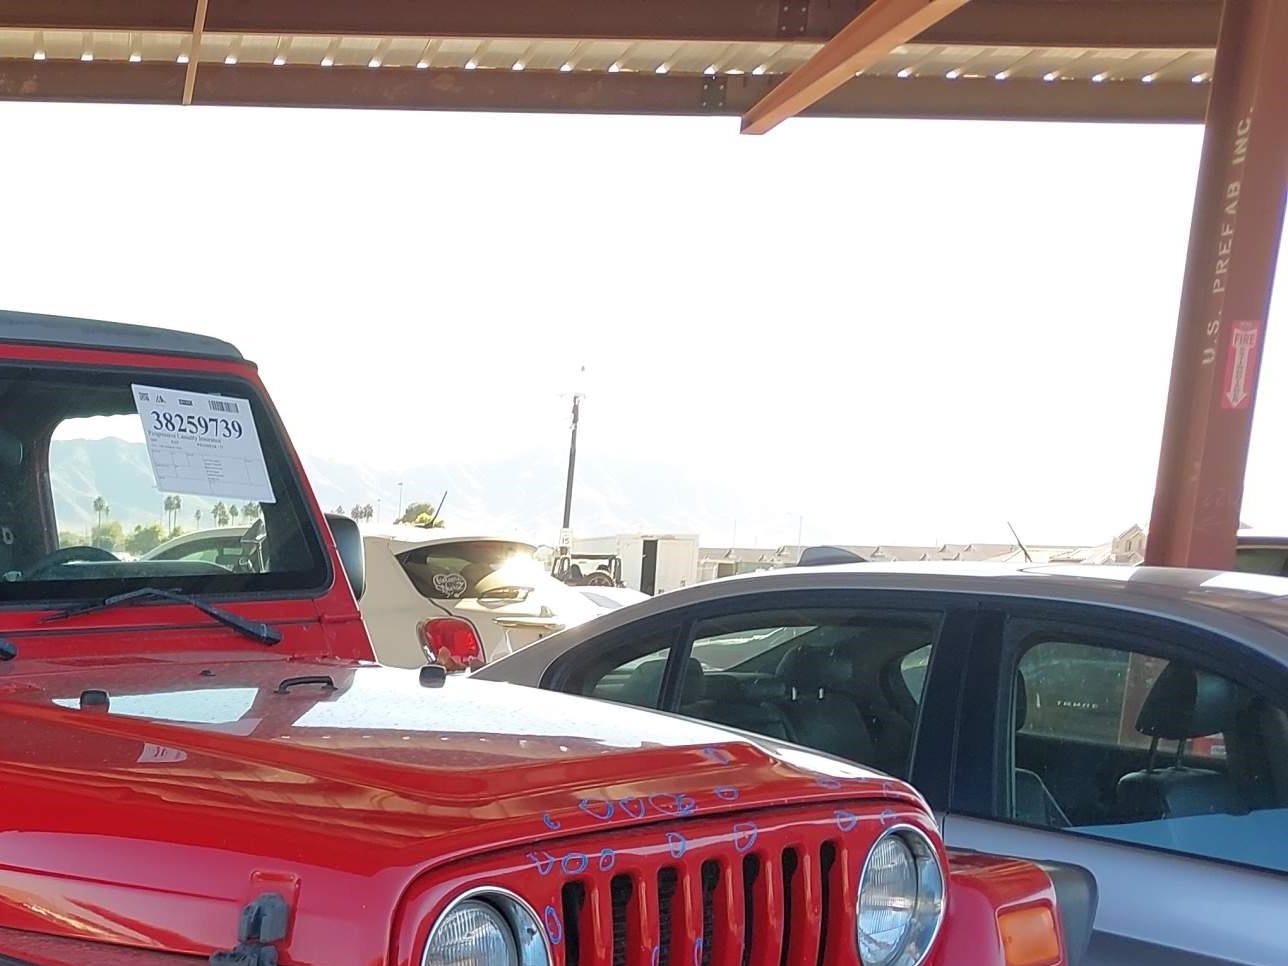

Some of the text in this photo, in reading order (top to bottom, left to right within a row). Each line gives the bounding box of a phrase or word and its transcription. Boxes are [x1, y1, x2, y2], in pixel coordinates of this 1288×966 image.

[1212, 181, 1240, 293] PREFAB
[1232, 106, 1253, 165] INC.
[150, 410, 243, 439] 38259739
